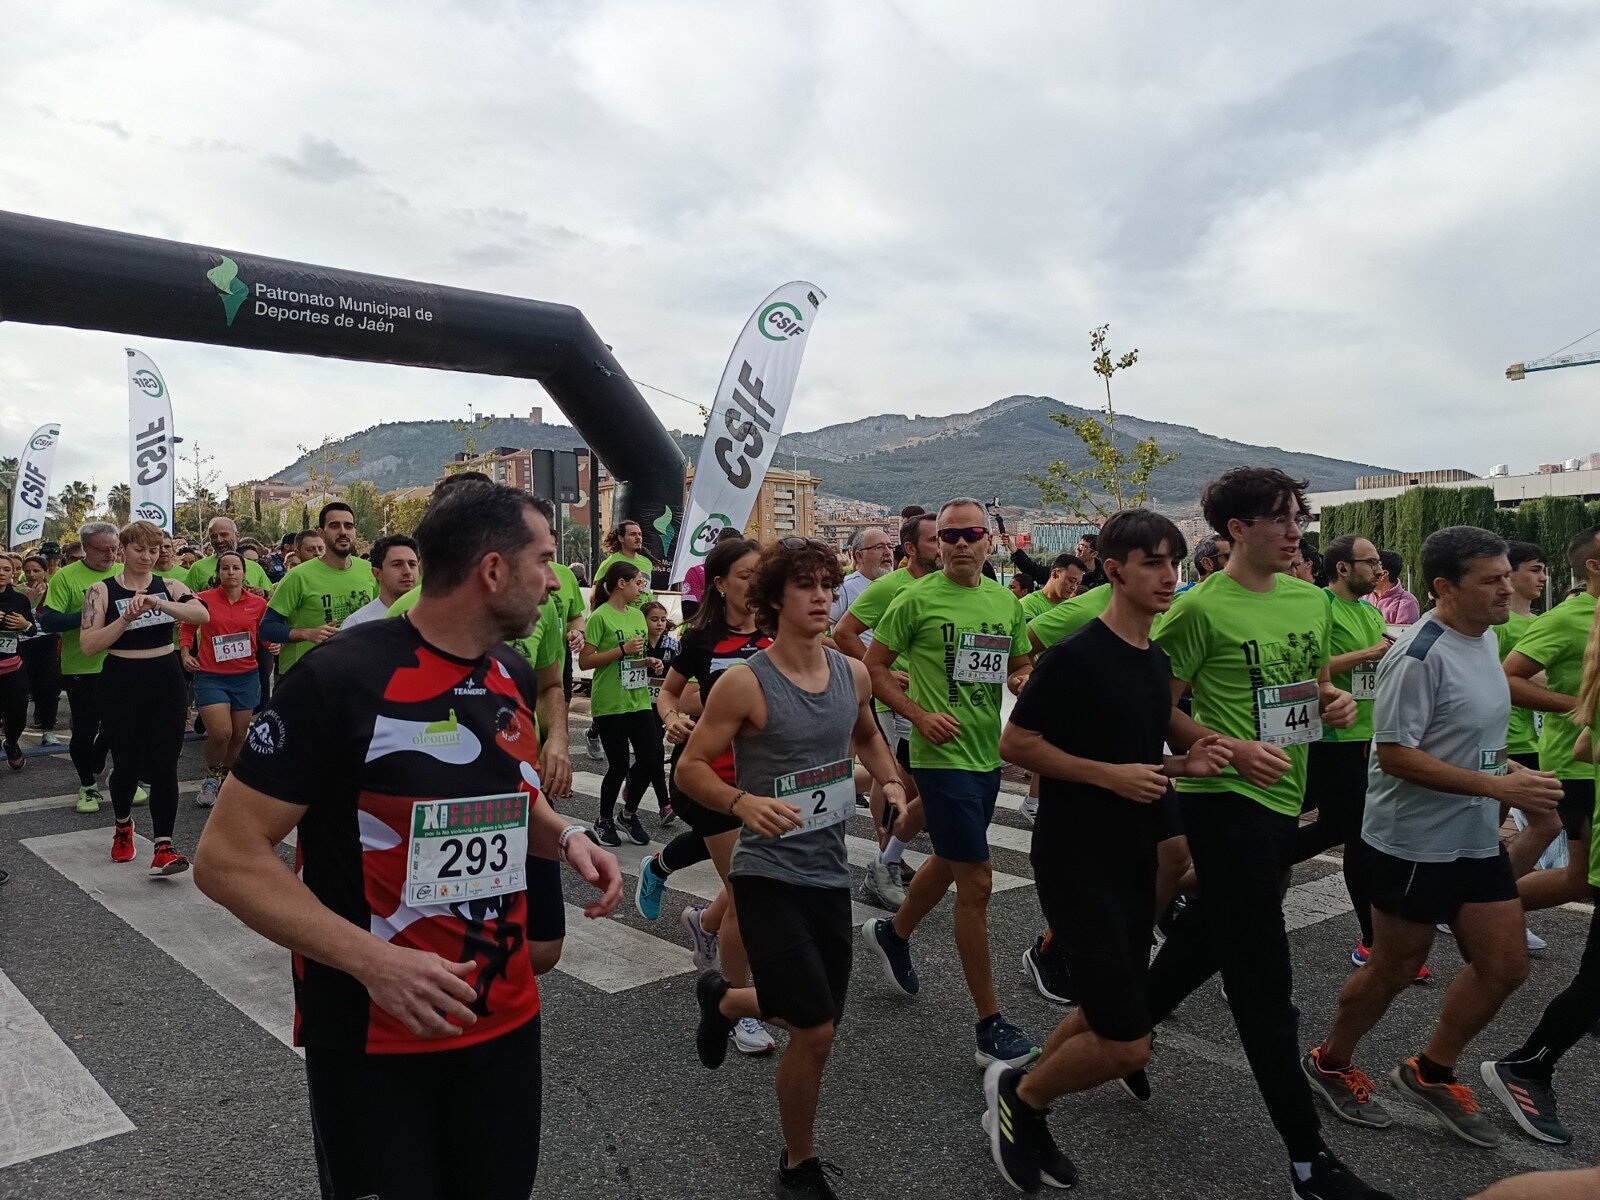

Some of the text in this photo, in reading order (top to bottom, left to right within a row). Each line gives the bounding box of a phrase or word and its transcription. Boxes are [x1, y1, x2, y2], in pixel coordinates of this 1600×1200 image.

[256, 283, 433, 322] Patronato Municipal de
[254, 301, 394, 333] Deportes de Jaén
[768, 311, 804, 338] CSIF
[714, 359, 776, 490] CSIF
[34, 438, 54, 448] CSIF
[20, 461, 46, 510] CSIF
[698, 525, 718, 544] CS
[321, 594, 331, 607] 17
[941, 623, 954, 642] 17
[964, 635, 975, 646] XI
[223, 642, 244, 654] 613
[1240, 640, 1260, 665] 17
[968, 652, 1002, 672] 348
[630, 670, 646, 682] 279
[1264, 689, 1280, 703] XI
[1286, 705, 1309, 730] 44
[412, 732, 461, 744] oleomar
[1484, 752, 1496, 765] XI
[781, 775, 796, 791] XI
[812, 790, 827, 815] 2
[422, 804, 448, 830] XI
[437, 834, 508, 878] 293
